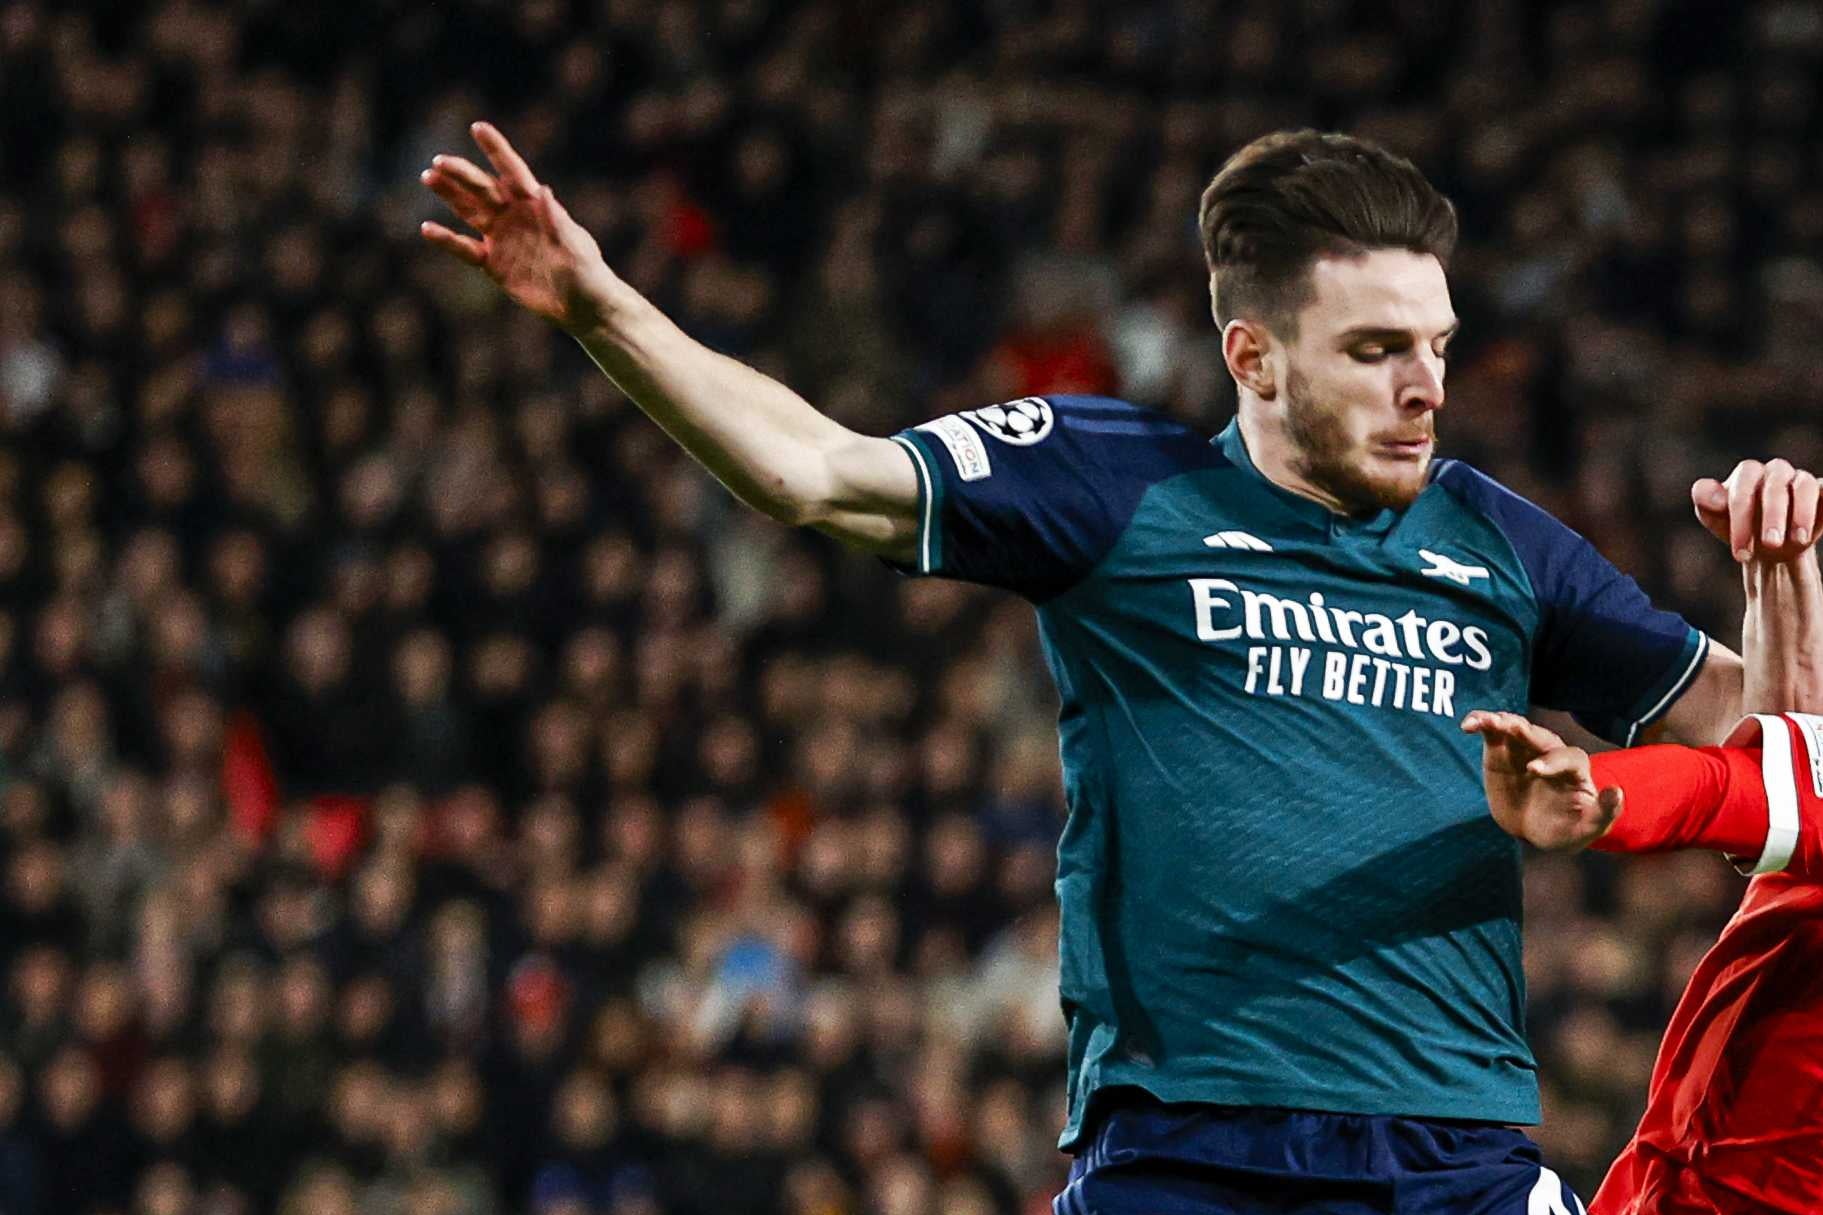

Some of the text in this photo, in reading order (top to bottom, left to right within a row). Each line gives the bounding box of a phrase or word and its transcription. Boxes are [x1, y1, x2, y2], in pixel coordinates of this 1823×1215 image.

[1187, 578, 1492, 671] Emirates
[1244, 646, 1456, 718] FLY BETTER
